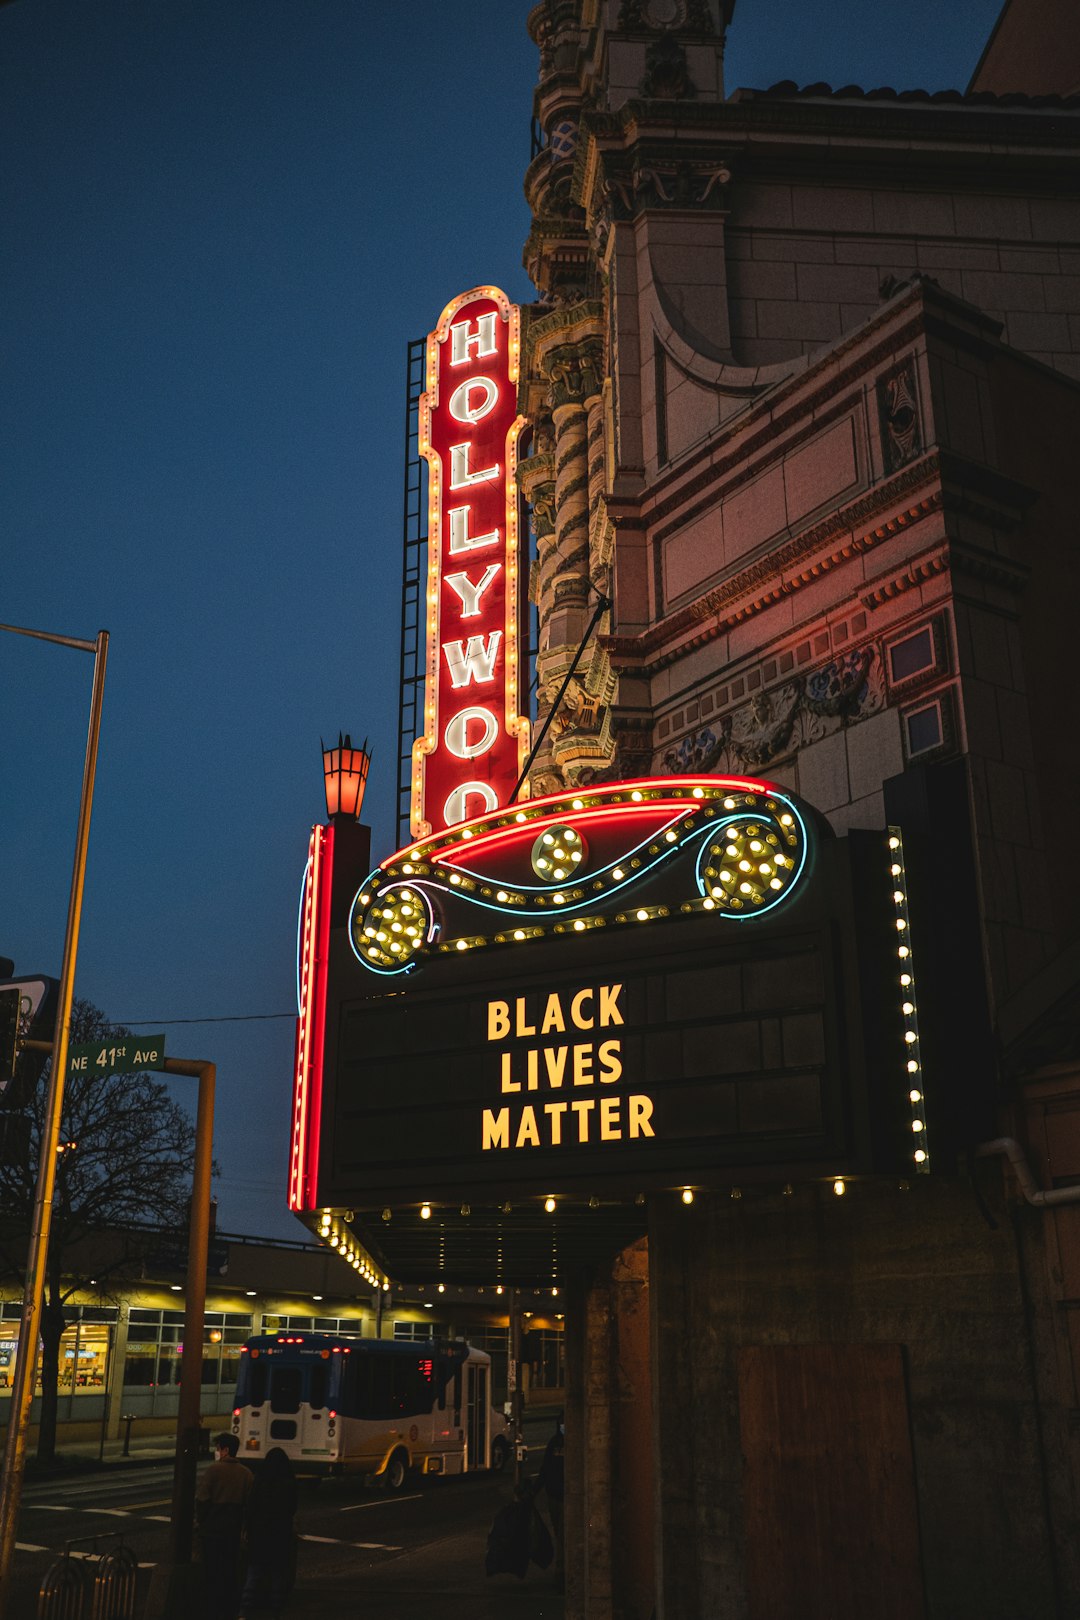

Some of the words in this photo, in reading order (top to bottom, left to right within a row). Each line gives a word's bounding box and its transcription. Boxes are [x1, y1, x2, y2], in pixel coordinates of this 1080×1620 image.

[487, 984, 625, 1041] BLACK
[71, 1056, 88, 1070] NE
[96, 1046, 126, 1067] 41st
[133, 1049, 158, 1064] Ave
[501, 1039, 623, 1094] LIVES
[482, 1094, 656, 1150] MATTER
[0, 1341, 16, 1351] EER
